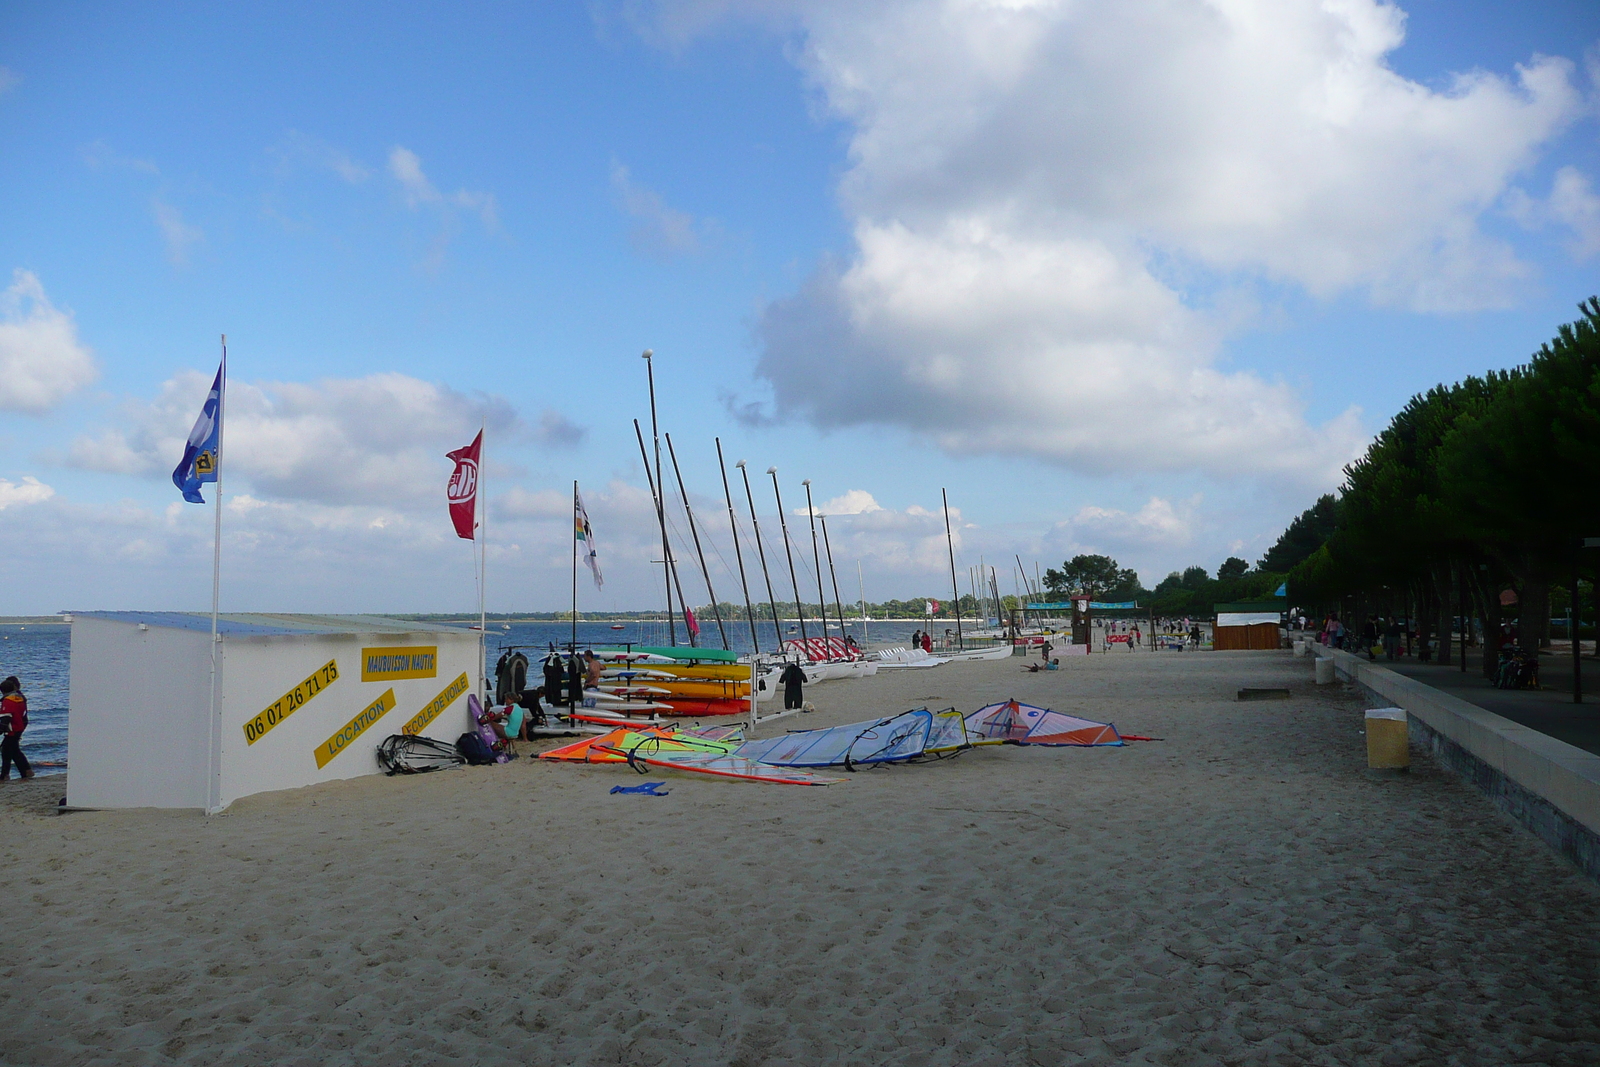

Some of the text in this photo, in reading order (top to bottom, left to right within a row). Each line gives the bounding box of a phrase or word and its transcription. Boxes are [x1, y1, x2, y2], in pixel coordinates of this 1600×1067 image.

[367, 654, 434, 673] MAUBUISSON NAUTIC
[246, 662, 338, 741] 06 07 26 71 75
[433, 695, 446, 713] DE
[444, 677, 467, 702] VOILE
[328, 700, 385, 755] LOCATION
